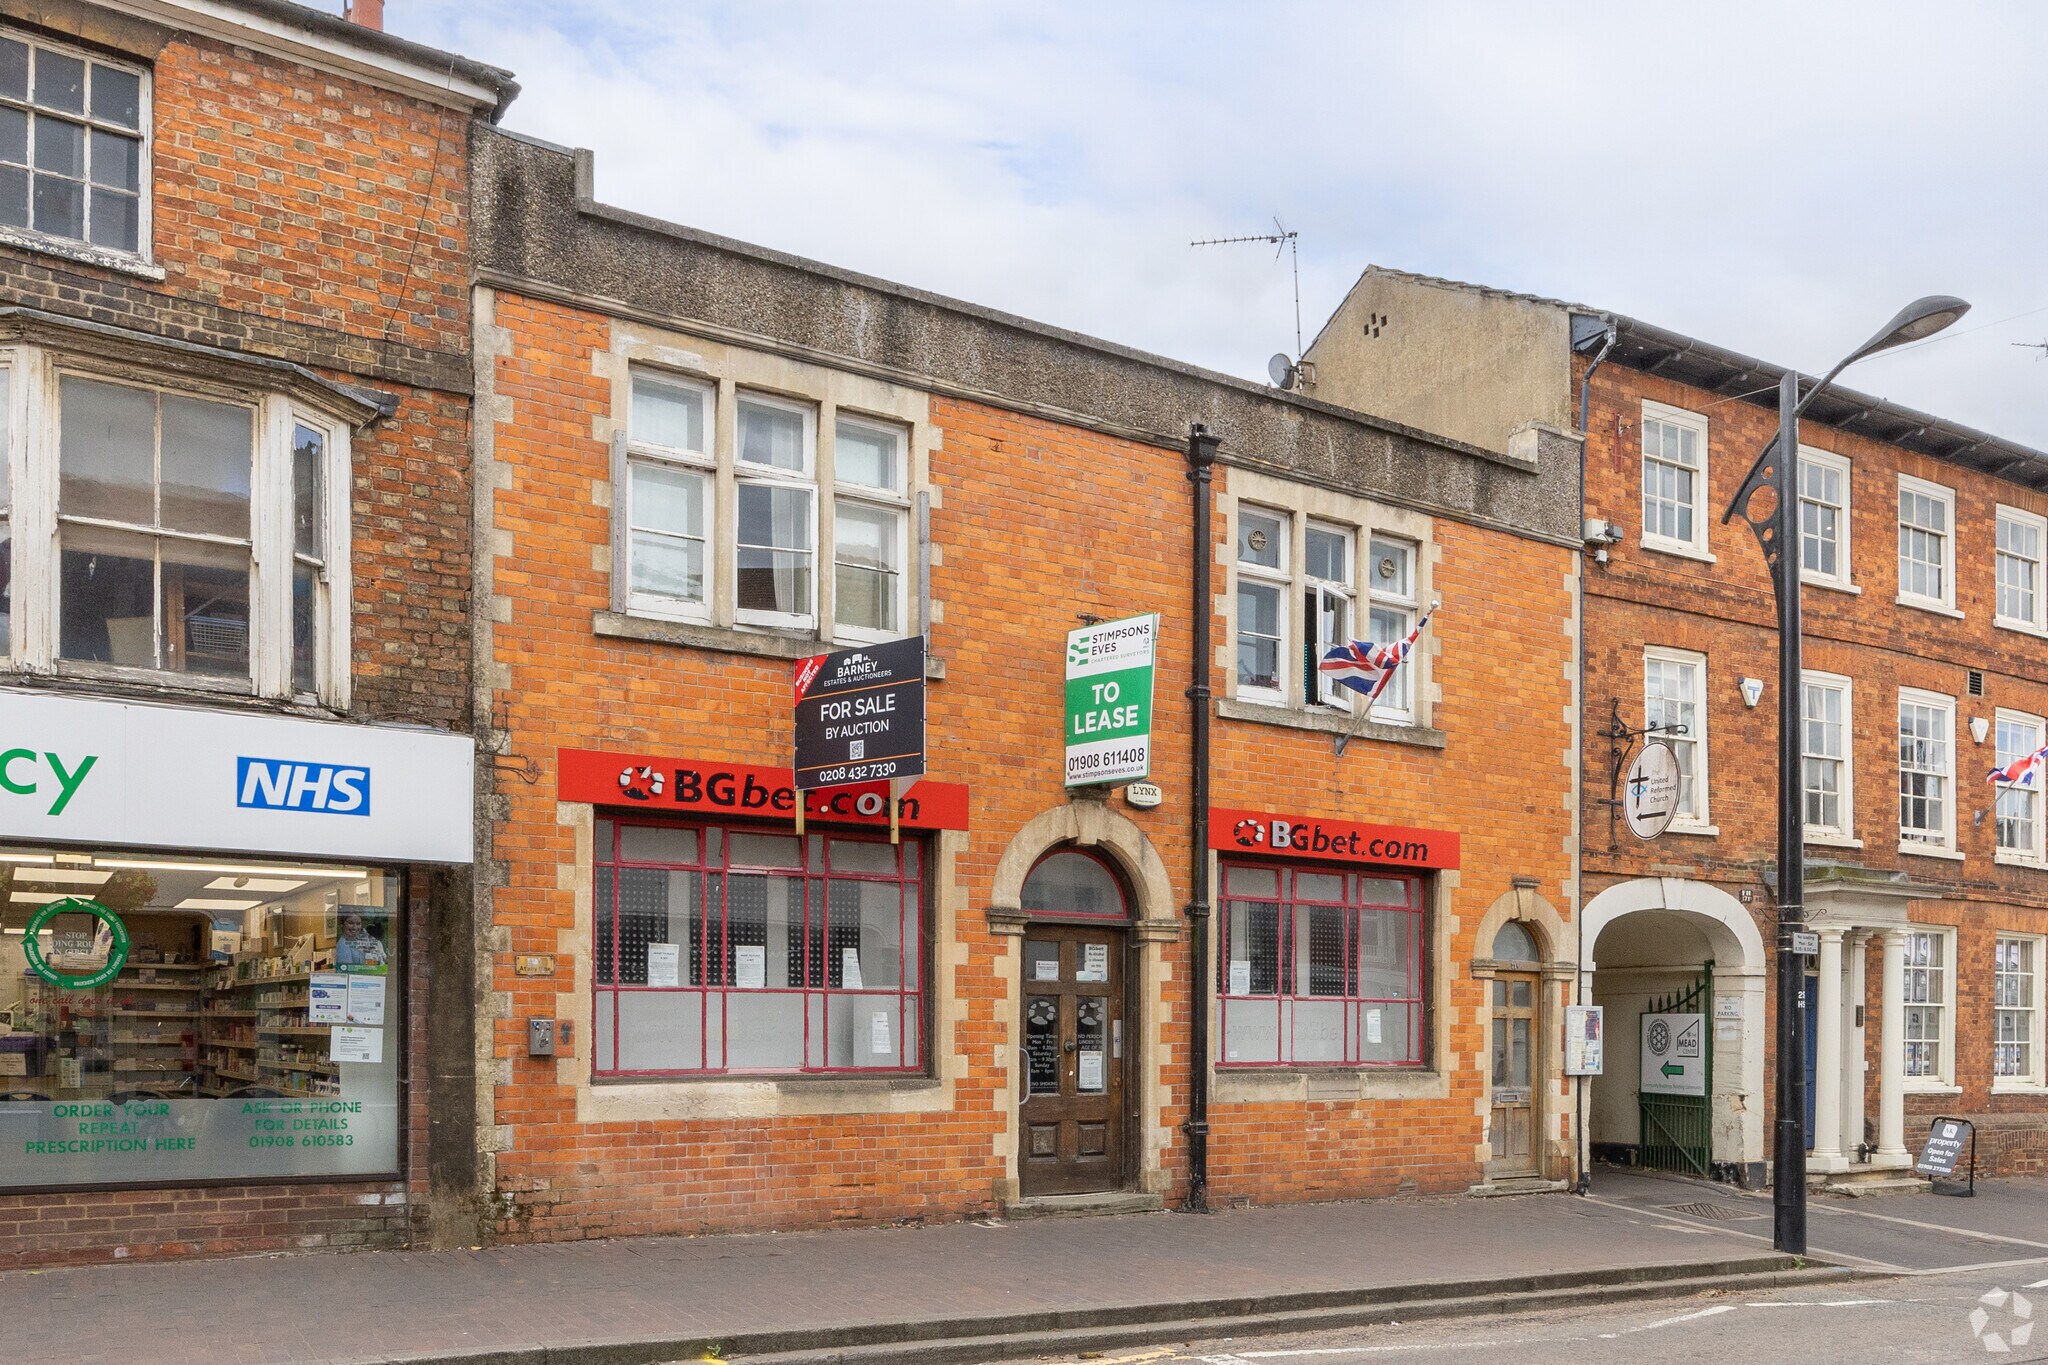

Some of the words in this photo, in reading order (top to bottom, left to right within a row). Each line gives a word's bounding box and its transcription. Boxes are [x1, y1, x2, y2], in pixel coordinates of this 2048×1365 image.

[1092, 624, 1149, 644] STIMPSONS
[1091, 642, 1117, 656] EVES
[1091, 654, 1119, 664] CHARTERED
[1120, 649, 1149, 659] SURVEYORS
[795, 658, 813, 687] BUSINESS
[837, 661, 878, 678] BARNEY
[800, 664, 819, 694] AFFECTED
[824, 677, 847, 687] ESTATES
[853, 670, 892, 682] AUCTIONEERS
[1092, 681, 1120, 705] TO
[820, 701, 851, 722] FOR
[855, 693, 896, 716] SALE
[1074, 704, 1138, 735] LEASE
[825, 726, 839, 740] BY
[840, 719, 889, 738] AUCTION
[1068, 753, 1100, 772] 01908
[1103, 747, 1145, 766] 611408
[819, 767, 846, 782] 0208
[848, 766, 867, 780] 432
[869, 762, 896, 777] 7330
[1068, 765, 1144, 780] www.stimpsonseves.co.uk
[0, 748, 98, 816] cy
[240, 762, 365, 812] NHS
[1650, 776, 1669, 785] United
[1133, 786, 1157, 796] LYNX
[1650, 784, 1676, 794] Reformed
[1649, 794, 1669, 804] Church
[1271, 820, 1428, 861] BGbet.com
[76, 940, 93, 948] ROU
[54, 1103, 113, 1118] ORDER
[123, 1102, 170, 1117] YOUR
[242, 1102, 272, 1114] ASK
[281, 1102, 302, 1114] OR
[310, 1101, 362, 1113] PHONE
[79, 1121, 139, 1135] REPEAT
[255, 1119, 285, 1131] FOR
[293, 1118, 348, 1130] DETAILS
[25, 1139, 147, 1154] PRESCRIPTION
[155, 1137, 196, 1150] HERE
[249, 1135, 294, 1148] 01908
[301, 1134, 354, 1147] 610583
[1928, 1137, 1961, 1149] property
[1928, 1156, 1946, 1164] Sales
[1944, 1149, 1955, 1157] for
